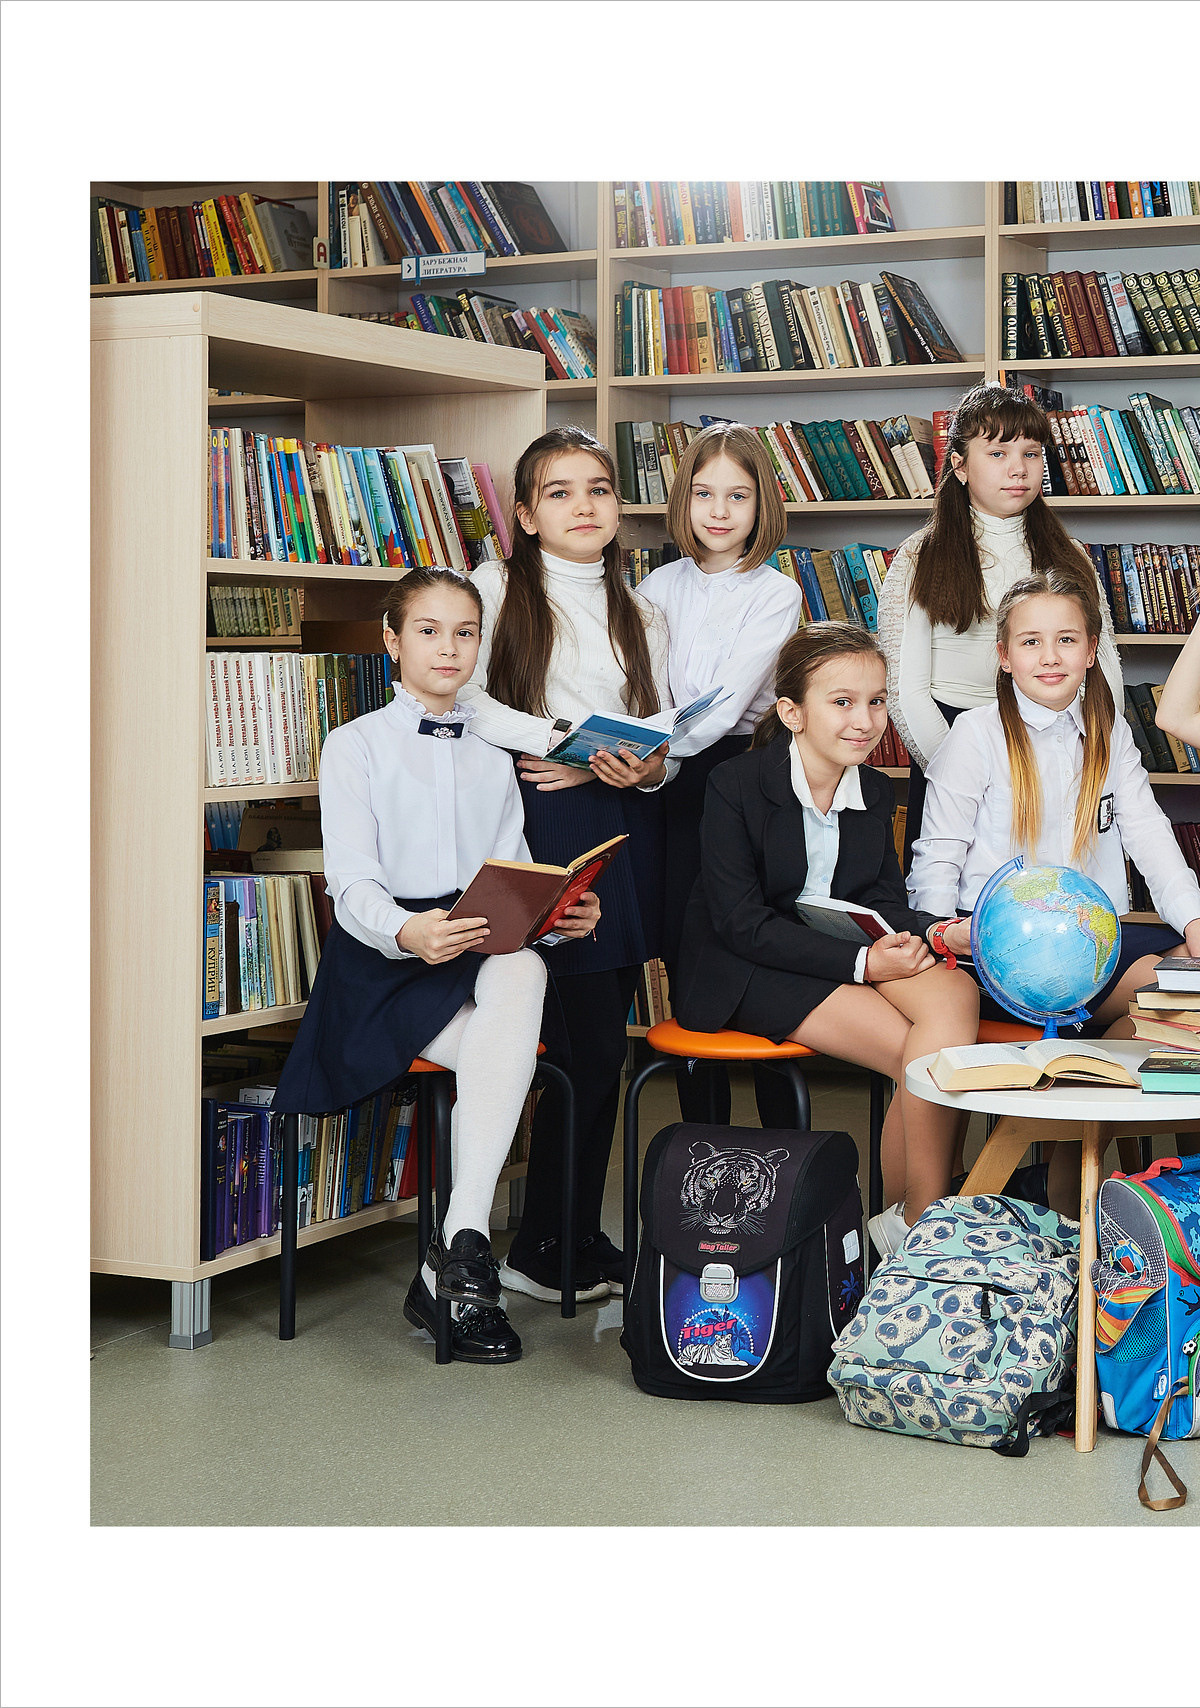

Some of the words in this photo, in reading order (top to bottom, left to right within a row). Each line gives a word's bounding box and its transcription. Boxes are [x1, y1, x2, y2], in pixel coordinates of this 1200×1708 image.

[421, 257, 468, 266] ЗАРУБЕЖНАЯ
[421, 267, 467, 276] ЛИТЕРАТУРА
[750, 285, 777, 358] БОККАЧЧО
[778, 293, 799, 342] ДЕКАМЕРОН
[1033, 314, 1046, 340] ГЮГО
[1050, 314, 1064, 340] ГЮГО
[1143, 311, 1159, 335] ГЮГО
[1159, 310, 1175, 334] ГЮГО
[1174, 309, 1190, 333] ГЮГО
[1006, 316, 1016, 346] ГЮГО
[207, 947, 216, 994] КУПРИН
[681, 1319, 738, 1339] Tiger
